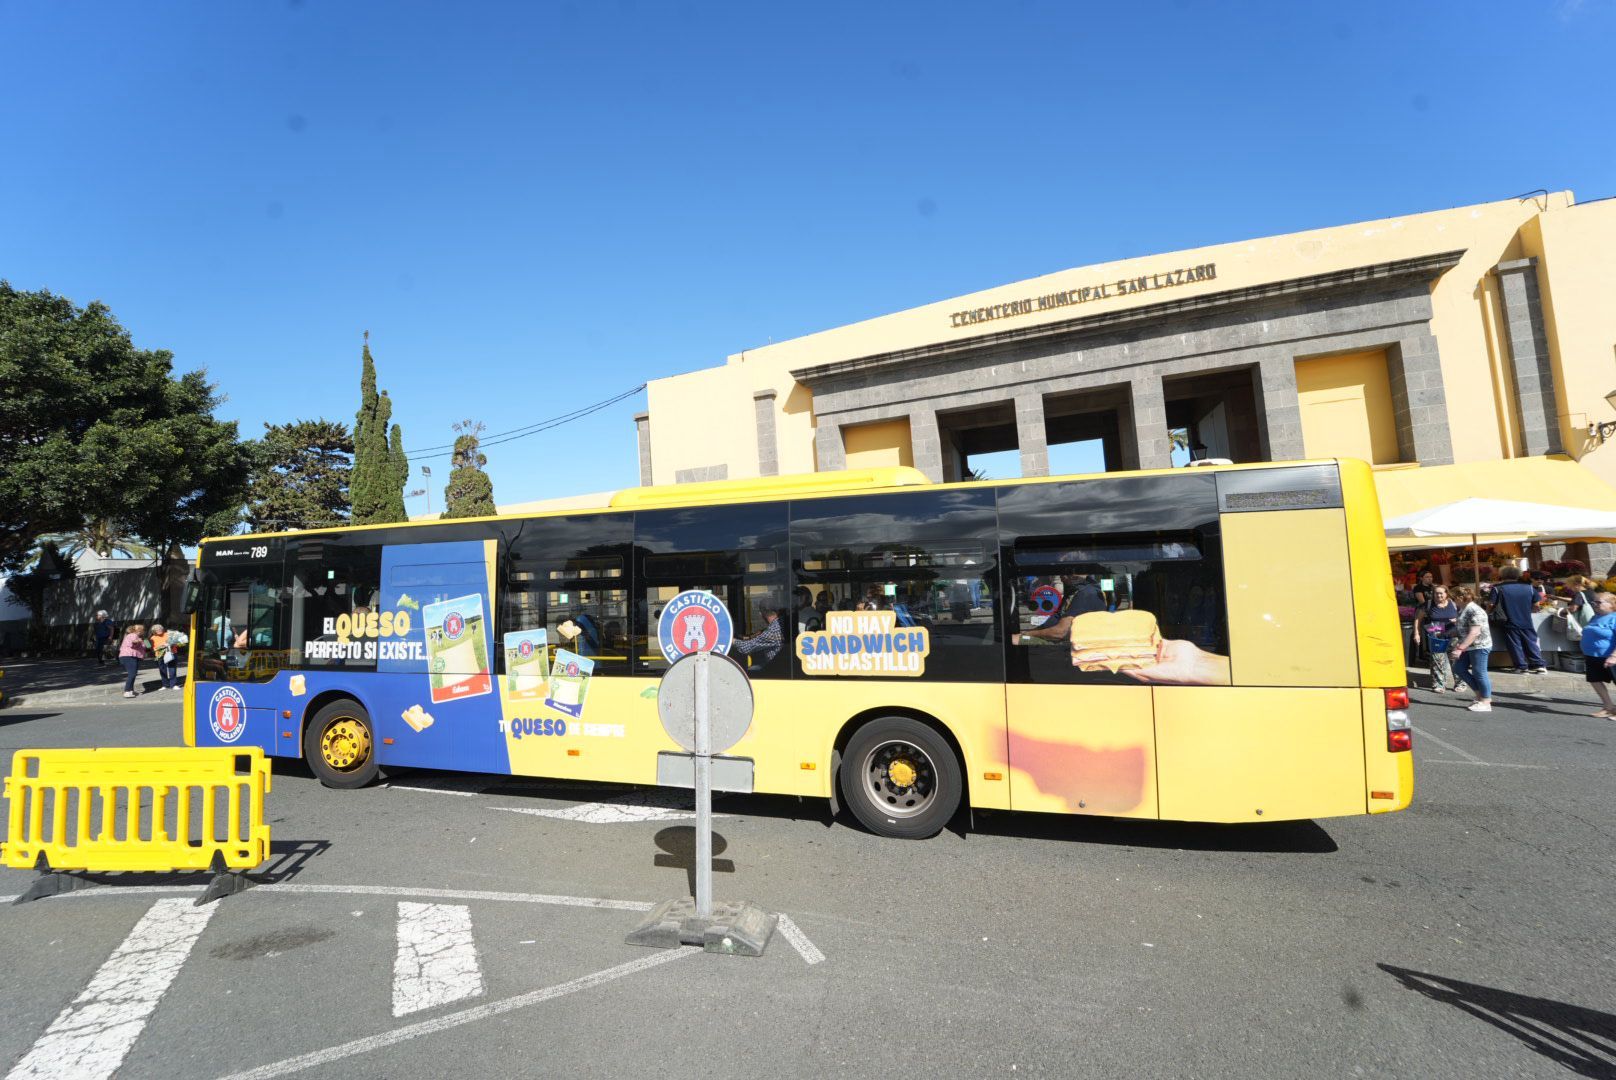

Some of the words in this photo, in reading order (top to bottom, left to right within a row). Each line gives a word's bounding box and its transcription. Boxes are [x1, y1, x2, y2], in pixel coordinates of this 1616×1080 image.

[950, 299, 1032, 328] CEMENTERIO
[1038, 283, 1112, 311] MUNICIPAL
[1117, 275, 1148, 297] SAN
[1153, 263, 1217, 290] LAZARO
[250, 545, 268, 559] 789
[669, 594, 720, 615] CASTILLO
[323, 617, 336, 635] EL
[336, 610, 411, 645] QUESO
[831, 615, 853, 635] NO
[857, 615, 891, 635] HAY
[305, 641, 362, 659] PERFECTO
[364, 642, 377, 660] SI
[665, 643, 679, 660] DE
[801, 632, 924, 656] SANDWICH
[806, 653, 835, 672] SIN
[838, 652, 920, 672] CASTILLO
[215, 689, 241, 704] CASTILLO
[219, 723, 243, 740] HOLANDA
[511, 718, 567, 740] QUESO
